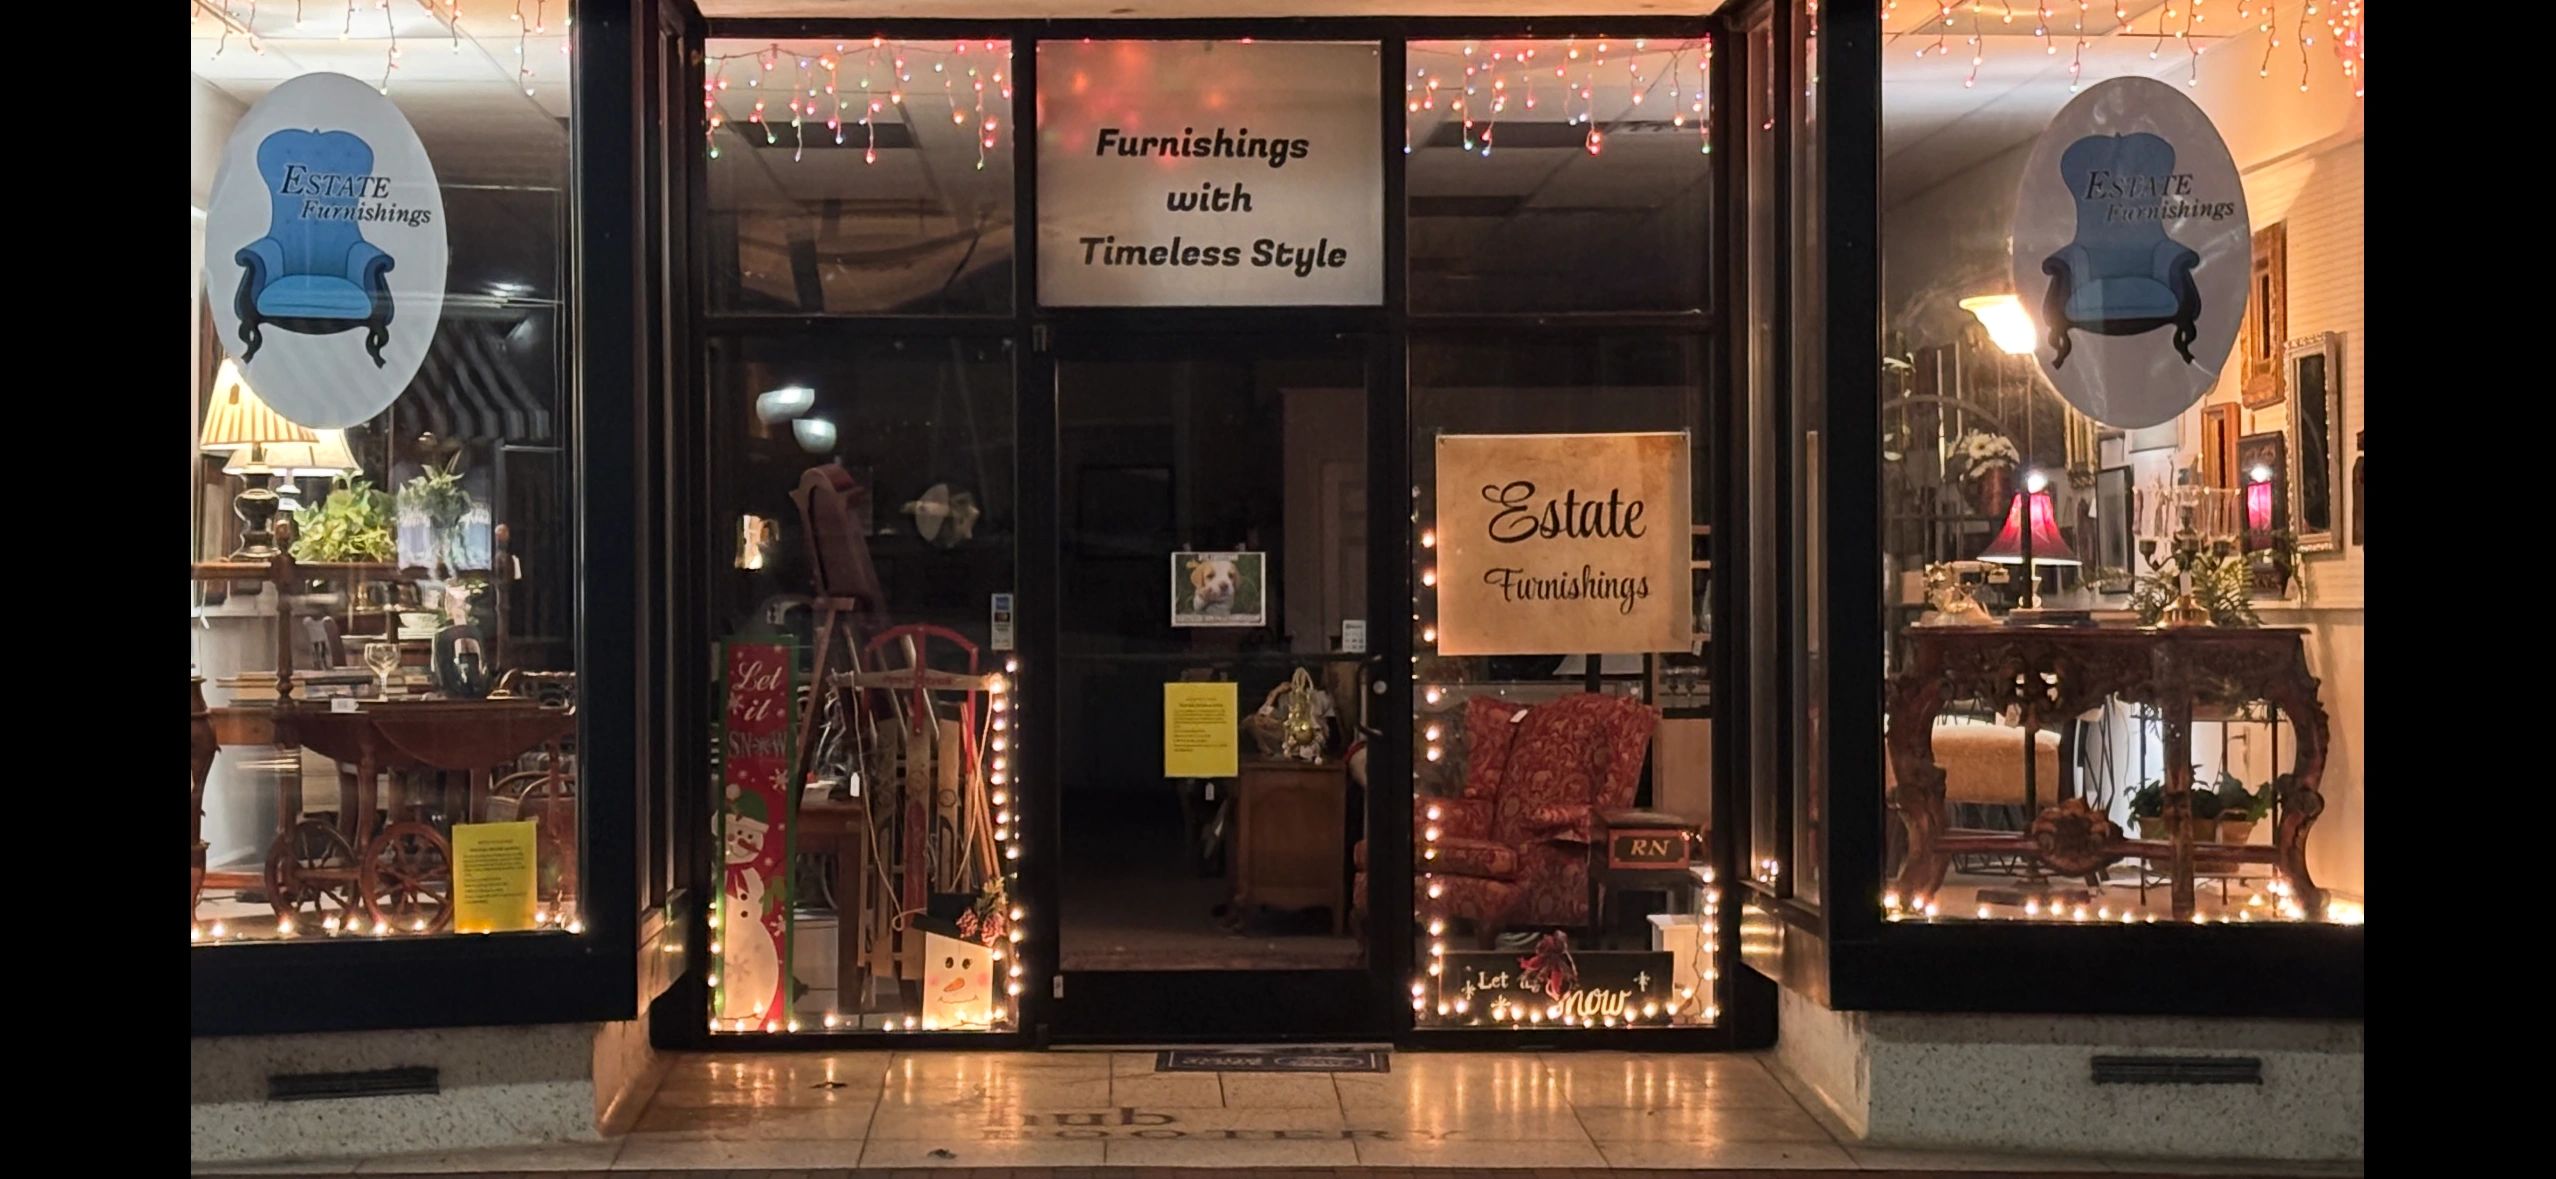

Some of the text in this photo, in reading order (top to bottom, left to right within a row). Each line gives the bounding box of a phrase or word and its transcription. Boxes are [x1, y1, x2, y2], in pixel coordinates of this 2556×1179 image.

[1096, 126, 1310, 169] Furnishings
[280, 163, 391, 199] ESTATE
[1166, 181, 1253, 212] with
[2085, 170, 2194, 200] ESTATE
[300, 199, 432, 228] Furnishings
[2106, 199, 2235, 222] Furnishings
[1079, 235, 1348, 278] Timeless Style
[1482, 480, 1648, 544] Estate
[1484, 564, 1651, 616] Furnishings
[731, 660, 783, 692] Let
[744, 698, 773, 722] it
[1630, 839, 1670, 857] RN
[1477, 971, 1509, 990] Let
